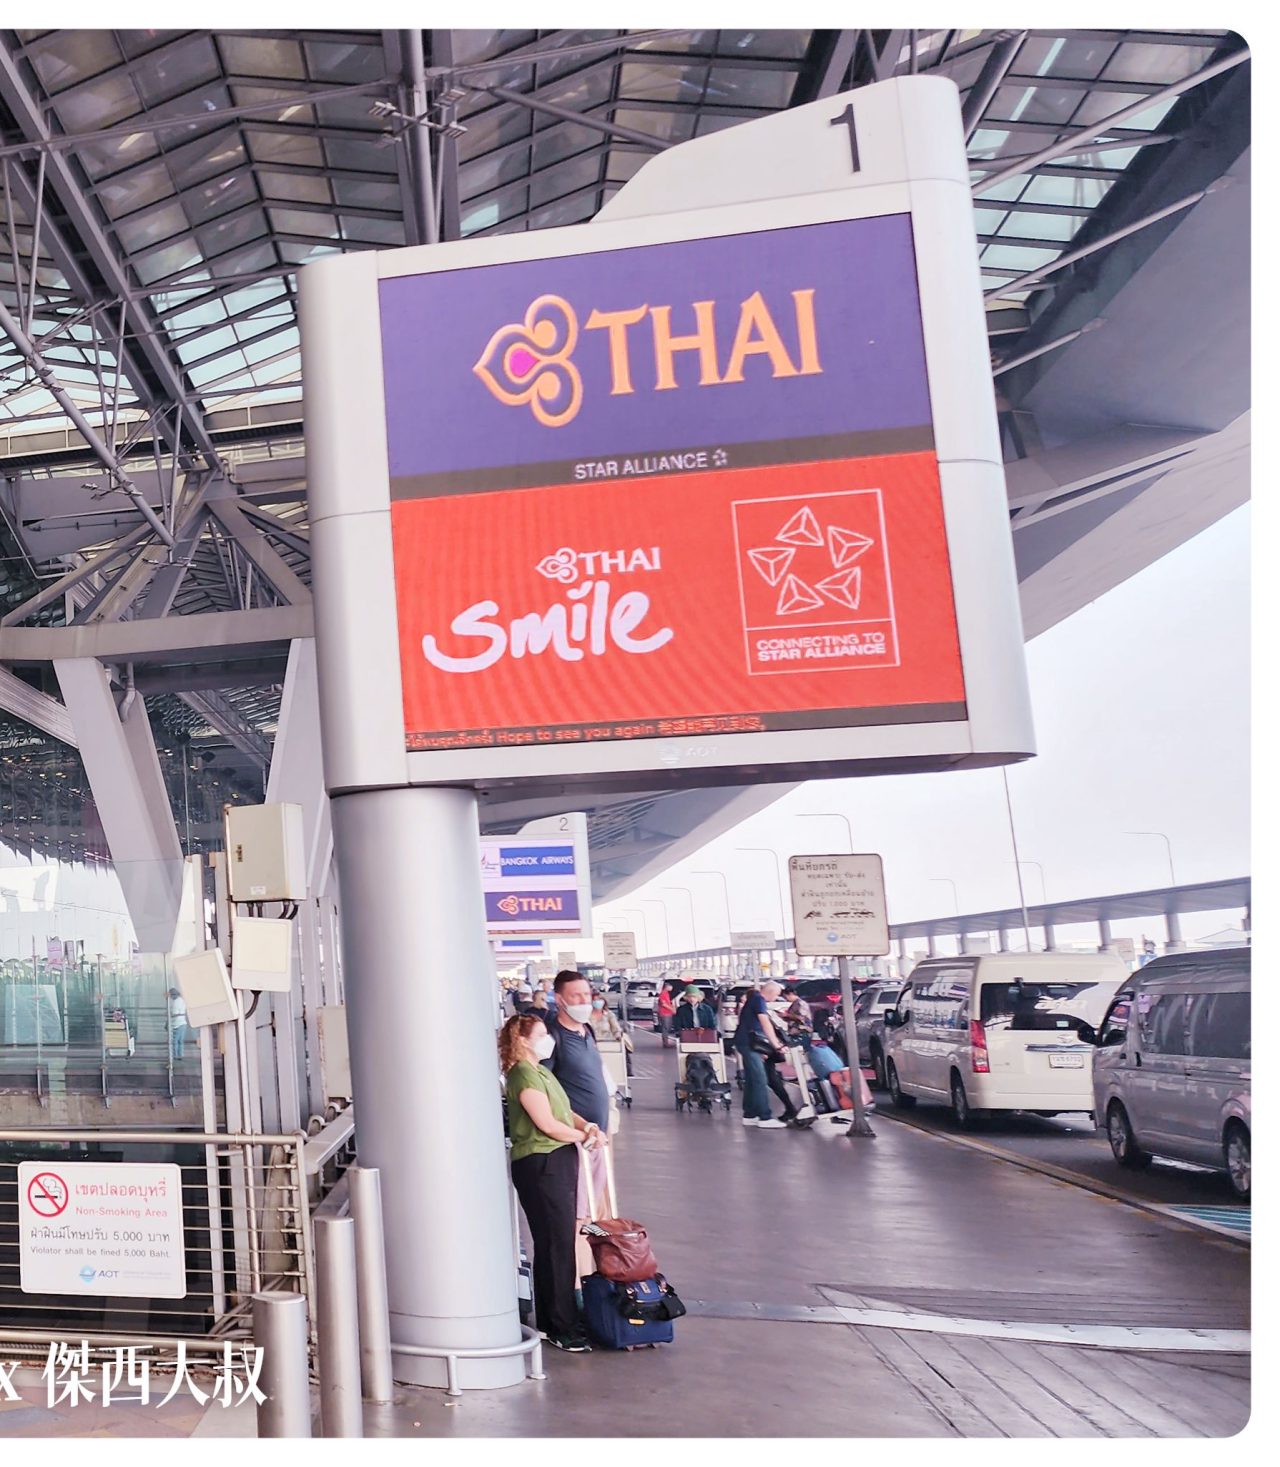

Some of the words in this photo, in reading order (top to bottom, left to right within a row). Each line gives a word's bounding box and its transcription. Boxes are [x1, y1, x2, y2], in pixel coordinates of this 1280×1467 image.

[829, 103, 862, 173] 1
[586, 288, 824, 396] THAI
[574, 461, 619, 480] STAR
[622, 451, 708, 475] ALLIANCE
[578, 547, 661, 577] THAI
[756, 633, 860, 650] CONNECTING
[862, 631, 886, 644] TO
[757, 648, 802, 662] STAR
[804, 643, 886, 659] ALLIANCE
[495, 730, 534, 745] Hope
[536, 729, 550, 741] to
[554, 730, 580, 740] see
[583, 727, 611, 742] you
[614, 723, 655, 739] again
[559, 817, 569, 832] 2
[500, 856, 539, 866] BANGKOK
[541, 855, 574, 865] AIRWAYS
[519, 897, 563, 911] THAI
[75, 1177, 167, 1203] เขตปลอดบุหรี่
[75, 1207, 141, 1219] Non-Smoking
[145, 1208, 168, 1218] Area
[147, 1232, 170, 1243] บาท
[30, 1246, 61, 1255] Violator
[64, 1247, 83, 1256] shall
[86, 1247, 97, 1256] be
[100, 1248, 121, 1257] fined
[124, 1249, 146, 1258] 5,000
[98, 1270, 120, 1279] AOT
